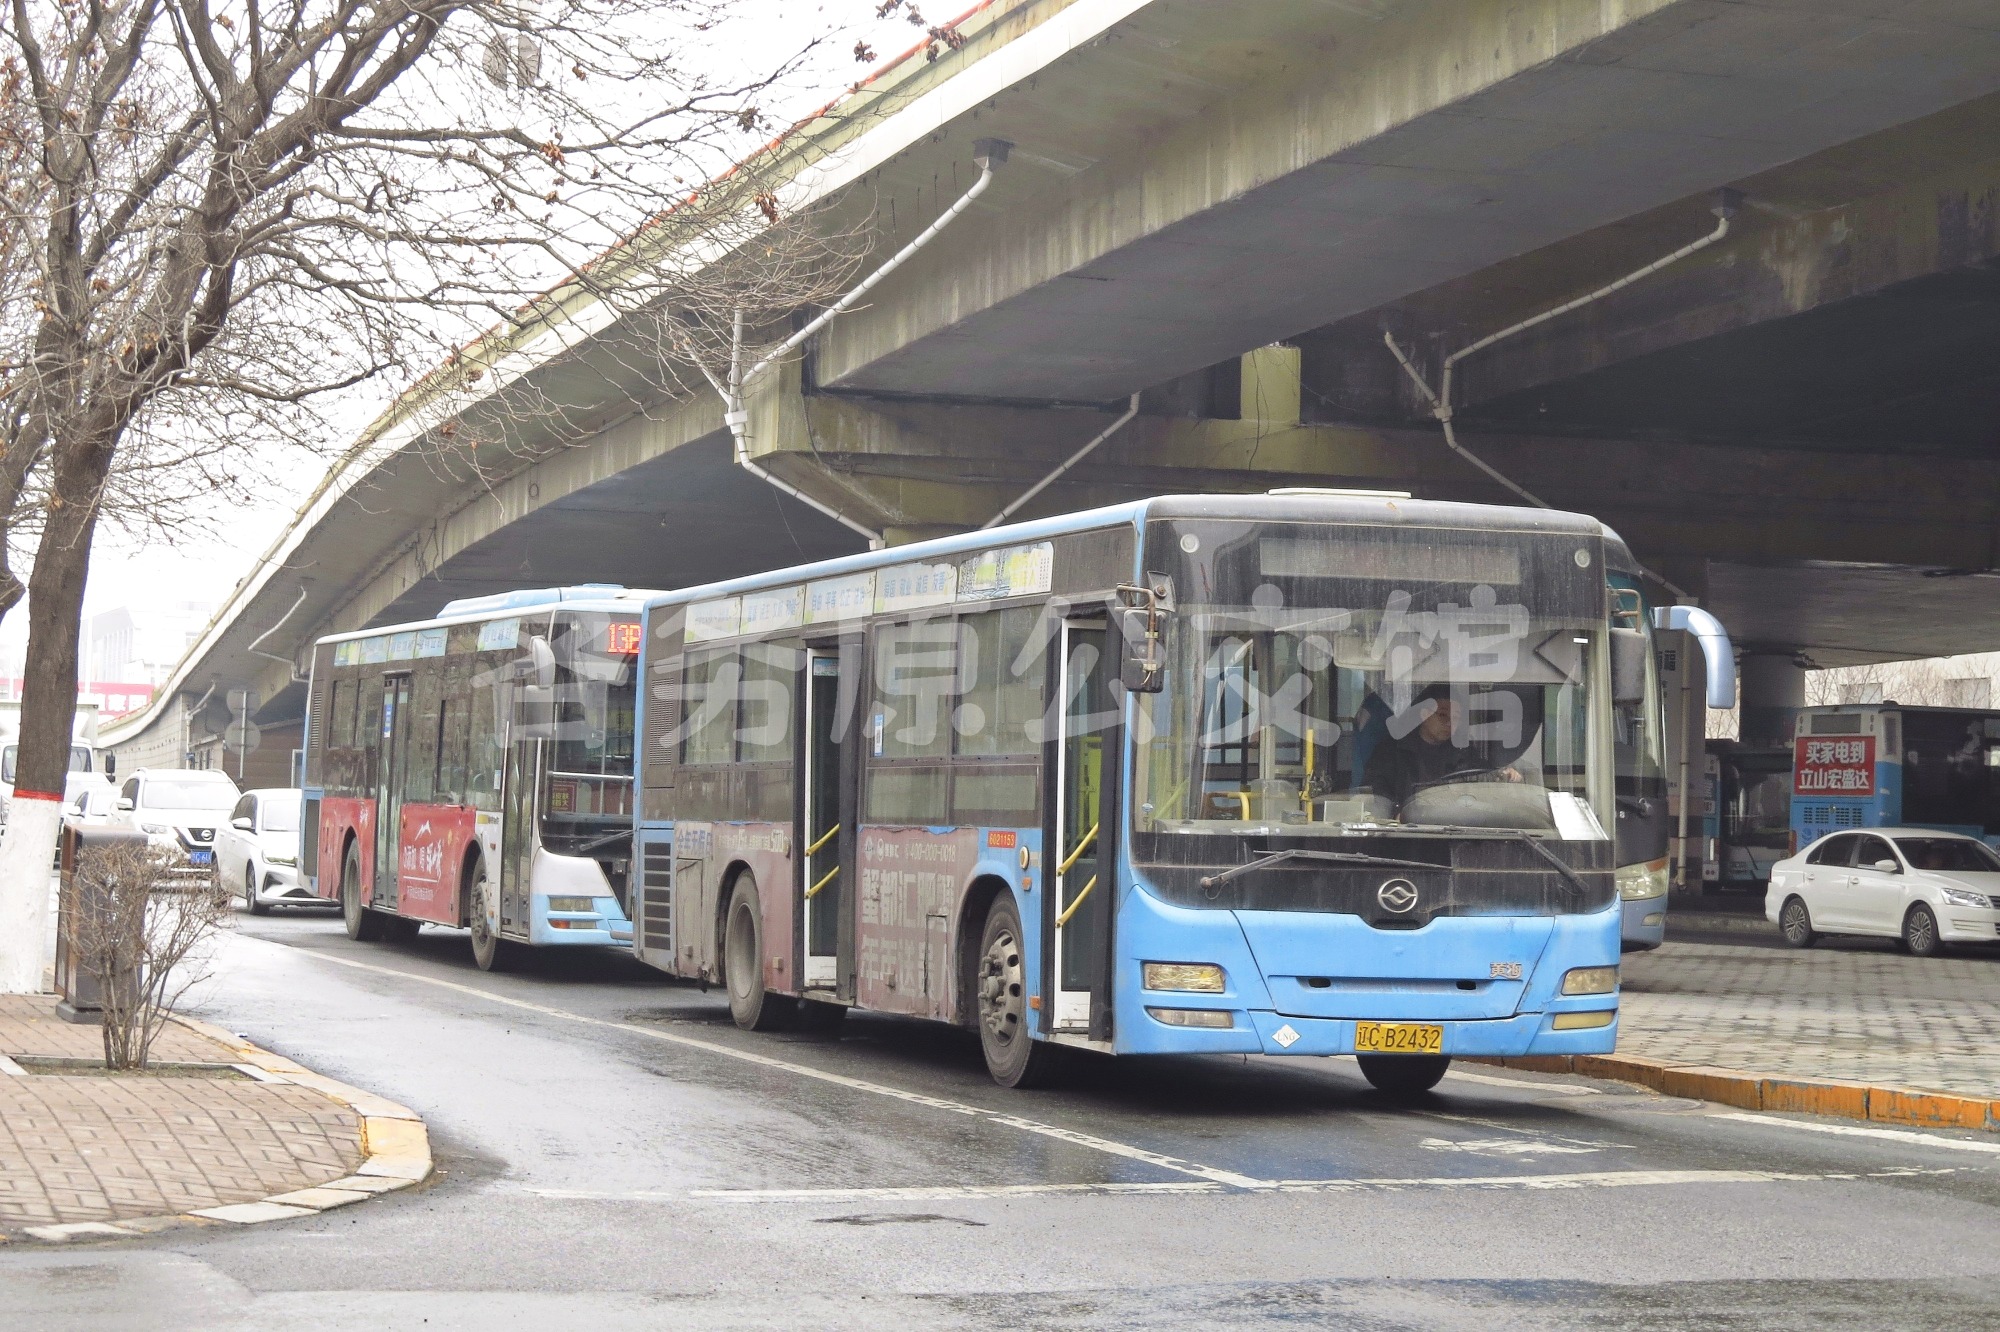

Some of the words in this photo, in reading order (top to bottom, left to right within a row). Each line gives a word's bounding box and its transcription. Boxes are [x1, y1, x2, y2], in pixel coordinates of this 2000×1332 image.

[1805, 741, 1866, 764] 买家电到
[1798, 768, 1870, 790] 立山宏盛达
[1489, 961, 1523, 980] 黄海
